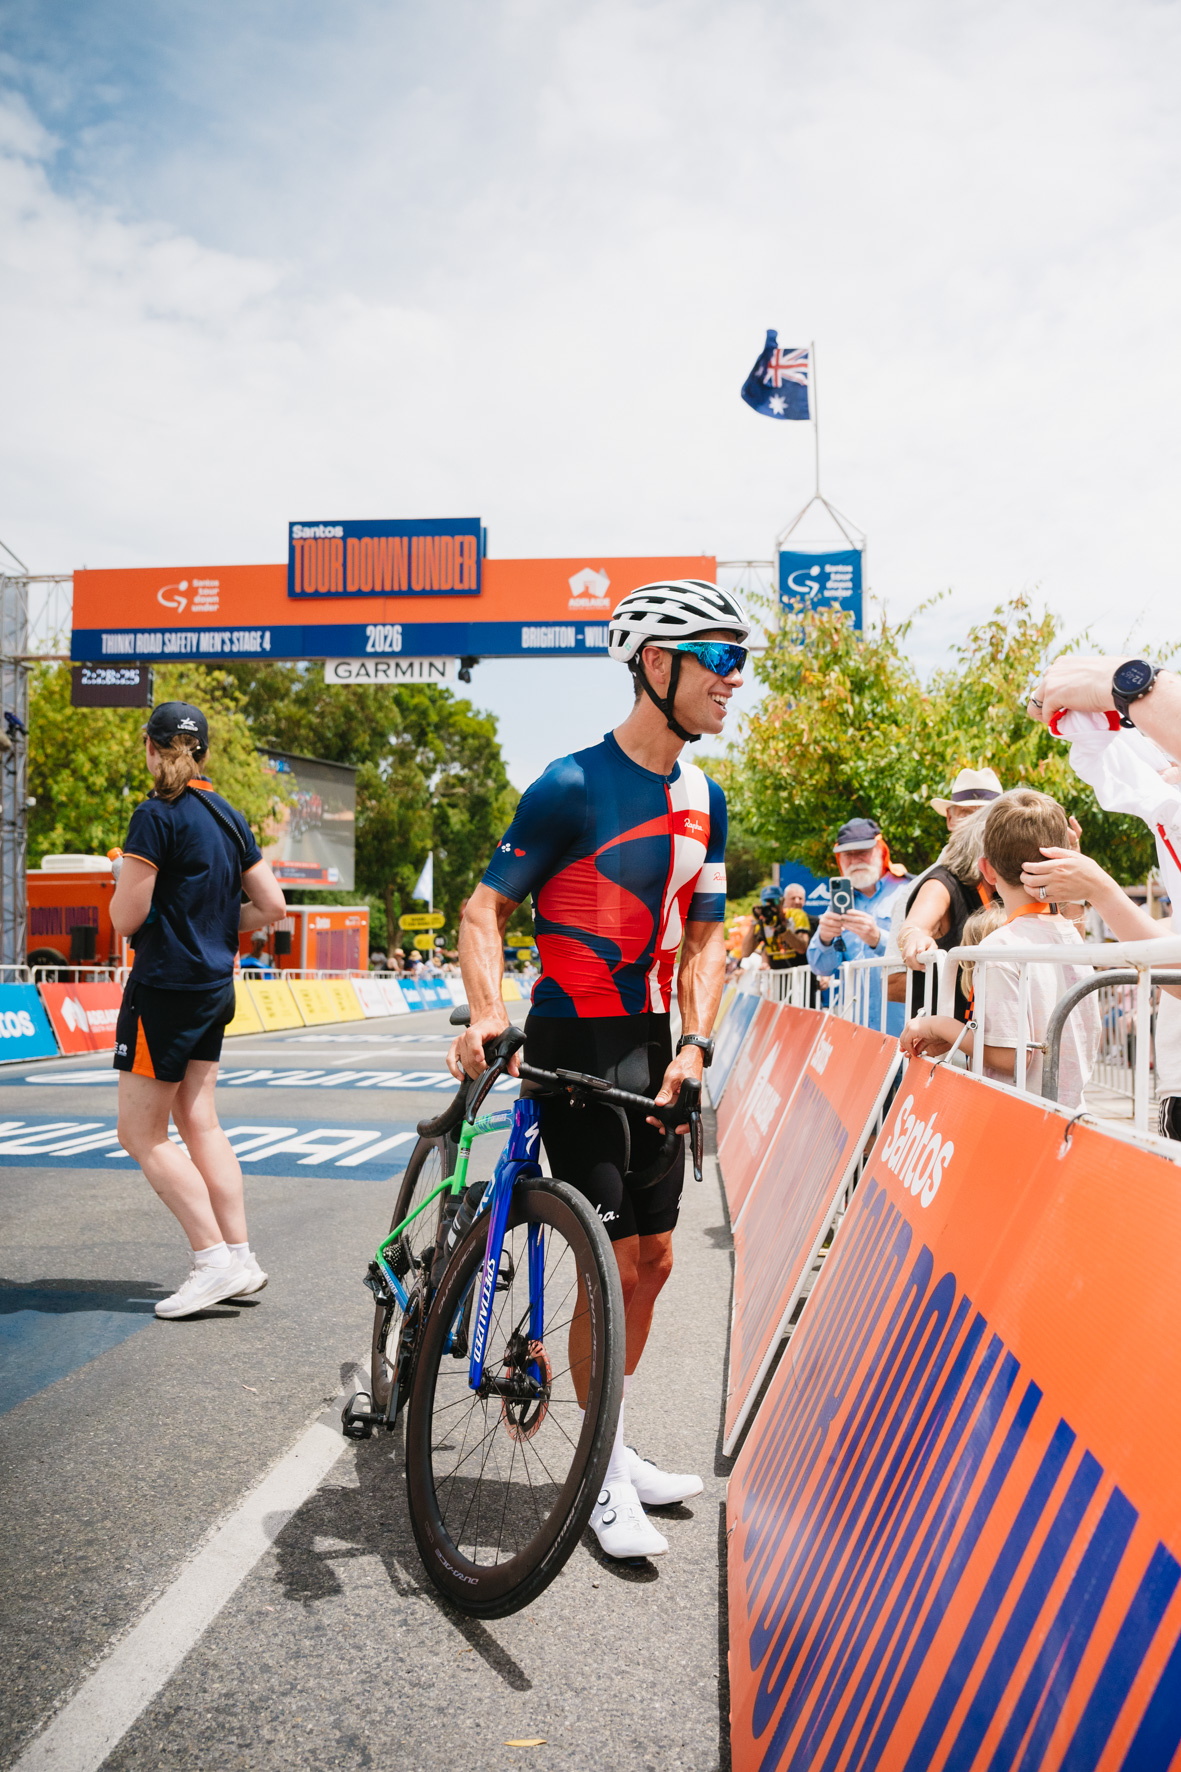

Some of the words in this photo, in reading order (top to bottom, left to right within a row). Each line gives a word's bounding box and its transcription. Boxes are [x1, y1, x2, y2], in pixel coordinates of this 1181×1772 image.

[292, 525, 344, 539] Santos
[292, 538, 344, 593] TOUR
[346, 536, 409, 592] DOWN
[411, 535, 477, 591] UNDER
[135, 633, 163, 654] ROAD
[163, 632, 199, 653] SAFETY
[200, 631, 231, 653] MEN'S
[232, 631, 262, 652] STAGE
[262, 630, 271, 652] 4
[365, 624, 402, 653] 2026
[521, 626, 576, 648] BRIGHTON
[334, 661, 446, 679] GARMIN
[683, 818, 704, 833] Rapha
[881, 1094, 954, 1208] Santos
[473, 1257, 496, 1363] SPECIALIZED
[434, 1547, 479, 1585] DURA-ACE
